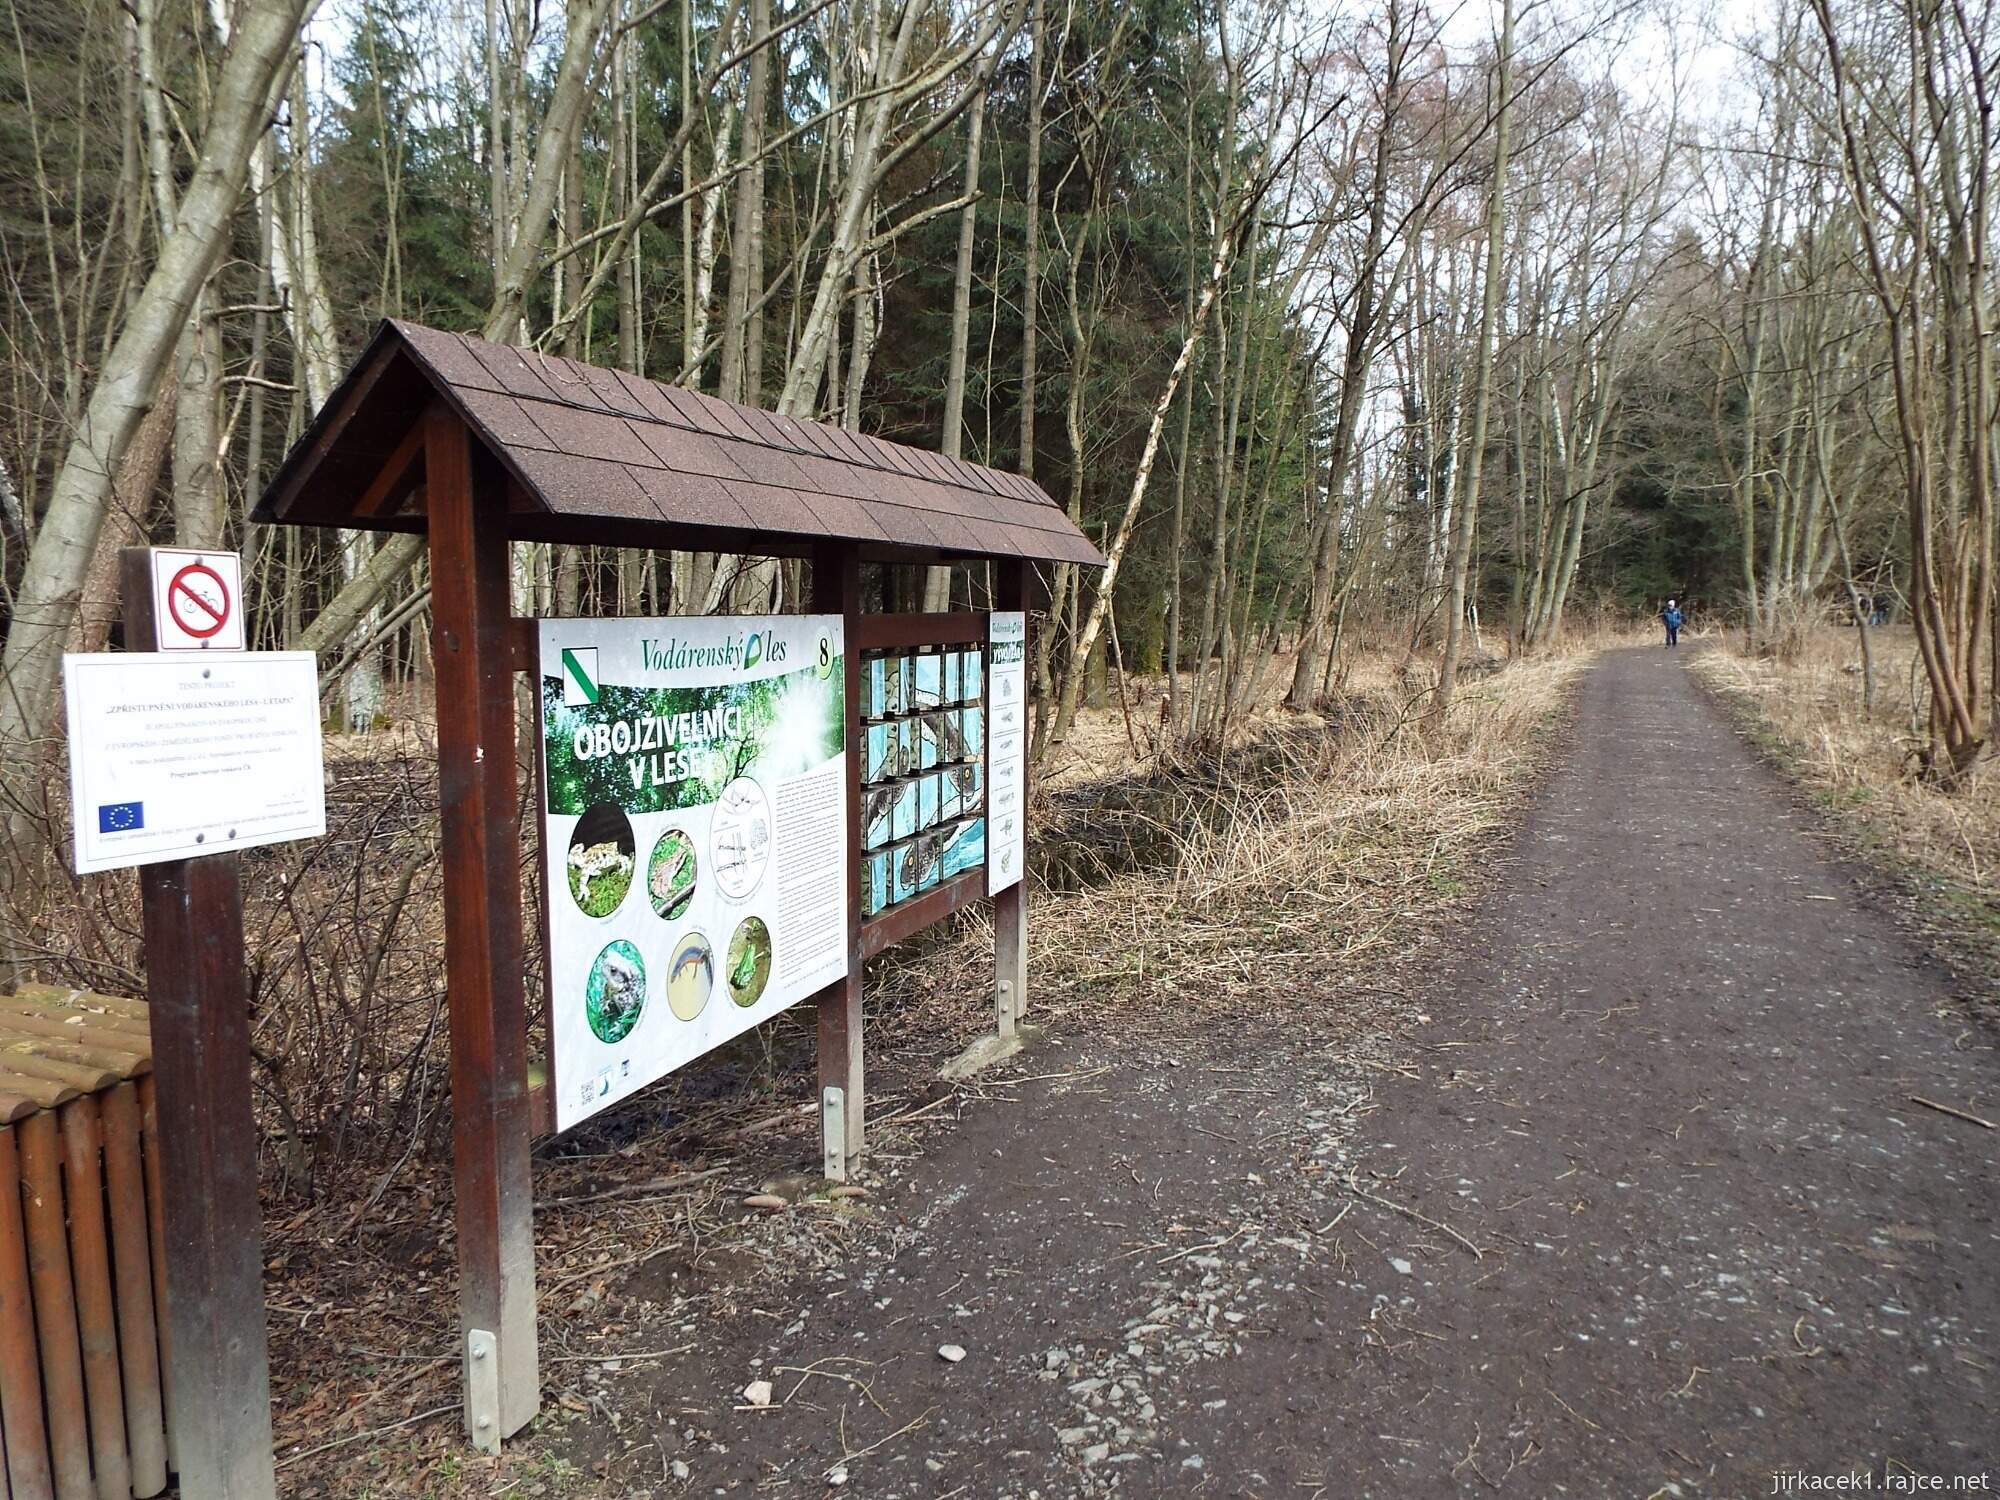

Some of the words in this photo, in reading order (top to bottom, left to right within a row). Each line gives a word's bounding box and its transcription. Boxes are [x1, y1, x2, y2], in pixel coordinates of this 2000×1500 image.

[642, 635, 744, 672] Vodárenský
[766, 630, 787, 662] les
[819, 637, 829, 667] 8
[628, 756, 647, 790] V
